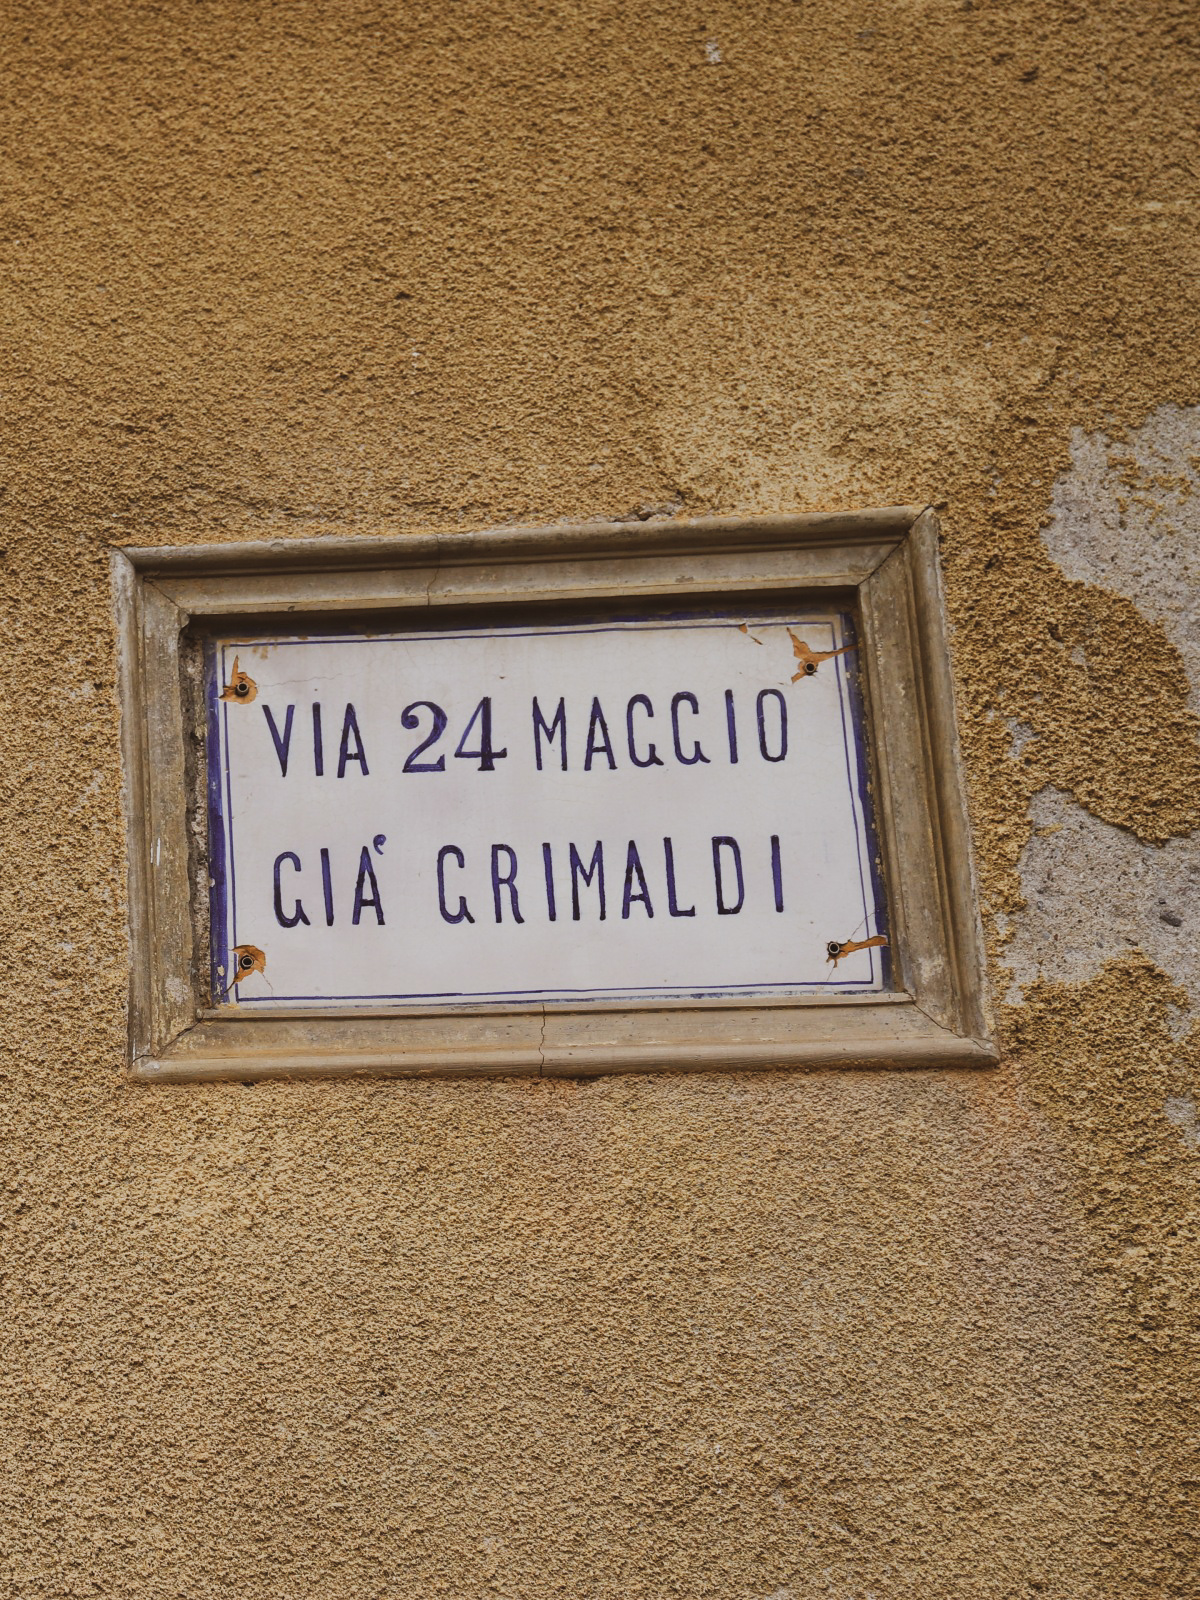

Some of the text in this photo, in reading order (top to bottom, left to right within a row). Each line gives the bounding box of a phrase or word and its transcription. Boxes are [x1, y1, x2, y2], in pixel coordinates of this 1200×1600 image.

[261, 687, 789, 779] VIA 24 MAGGIO
[436, 833, 785, 925] GRIMALDI
